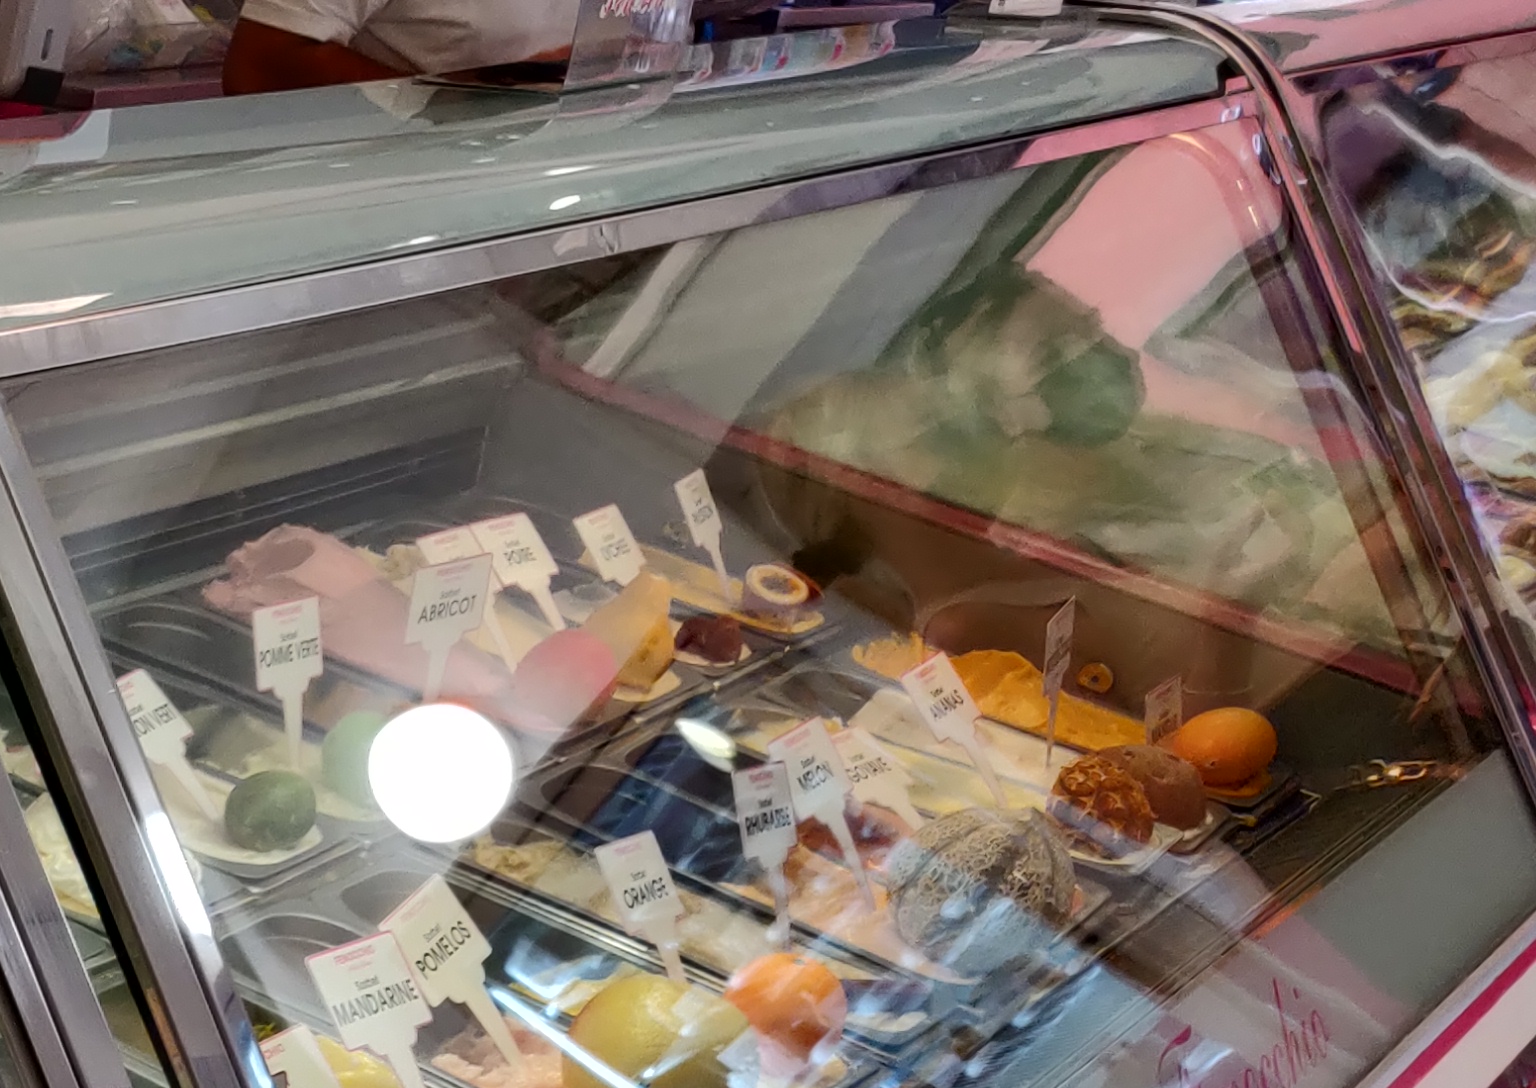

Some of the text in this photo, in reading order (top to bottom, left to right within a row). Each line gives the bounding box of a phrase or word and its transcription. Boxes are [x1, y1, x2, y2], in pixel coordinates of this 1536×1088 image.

[417, 595, 478, 625] ABRICOT
[624, 877, 669, 909] ORANGE
[415, 920, 472, 980] POMELOS
[332, 978, 420, 1028] MANDARINE
